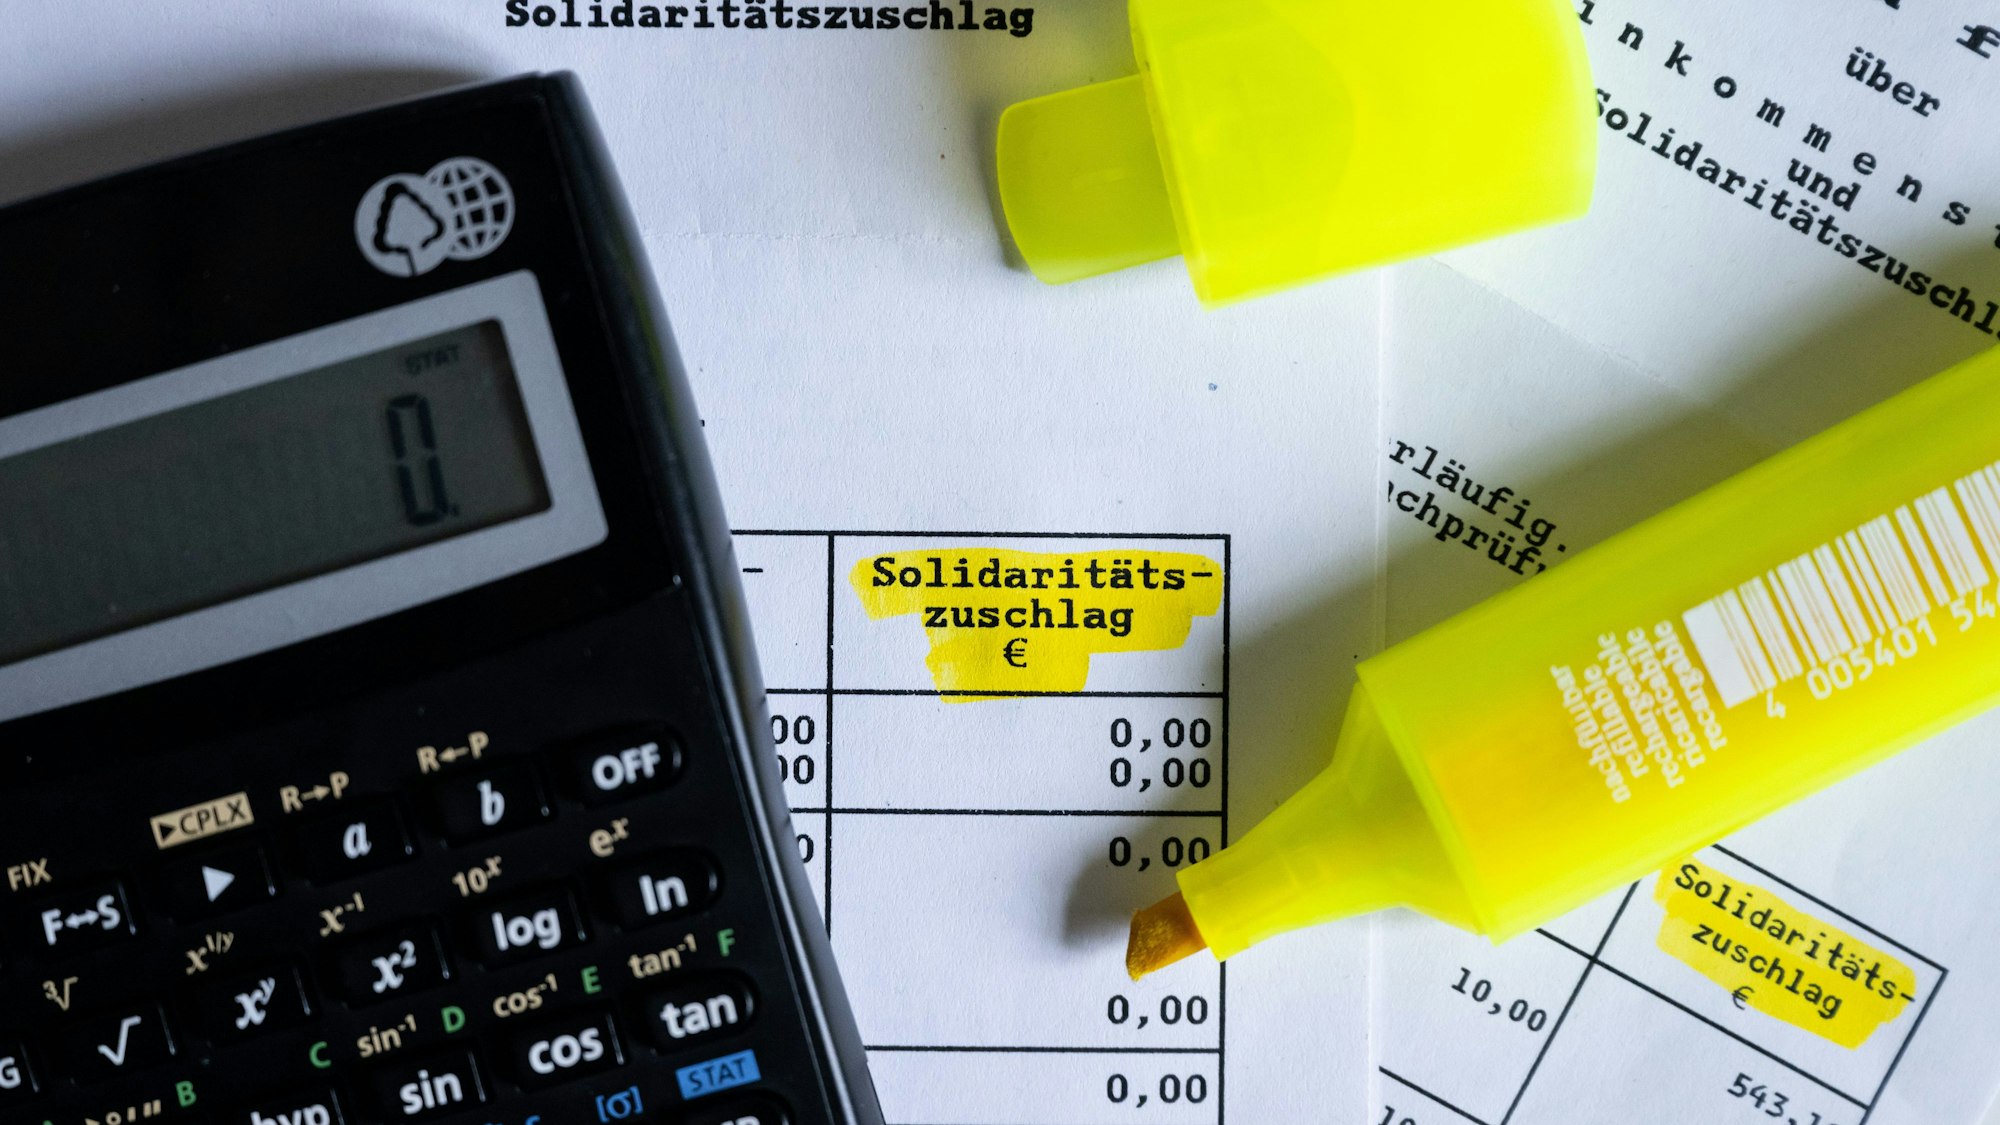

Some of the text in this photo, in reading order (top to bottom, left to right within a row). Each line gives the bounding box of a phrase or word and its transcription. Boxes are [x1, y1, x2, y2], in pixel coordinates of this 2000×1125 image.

[506, 0, 1035, 38] Solidaritätszuschlag
[1846, 46, 1940, 118] über
[1787, 158, 1861, 212] und
[1596, 88, 2000, 341] olidaritätszuschl
[405, 343, 460, 375] STAT
[1389, 438, 1566, 553] rläufig.
[1388, 481, 1546, 575] chprüf
[872, 556, 1213, 591] Solidaritäts-
[924, 598, 1134, 638] zuschlag
[1002, 638, 1028, 668] €
[1806, 614, 1937, 701] 005401
[1950, 587, 2000, 633] 54
[1109, 718, 1212, 752] 0,00
[1583, 663, 1649, 778] refillable
[592, 742, 661, 790] OFF
[1109, 757, 1211, 790] 0,00
[179, 799, 247, 837] CPLX
[477, 780, 505, 825] b
[343, 823, 372, 859] a
[1108, 836, 1210, 871] 0,00
[7, 857, 52, 891] FIX
[492, 908, 562, 951] log
[718, 928, 736, 957] F
[1674, 864, 1916, 1003] Solidaritäts-
[581, 966, 601, 994] E
[1691, 924, 1843, 1020] zuschlag
[660, 994, 738, 1039] tan
[1107, 994, 1208, 1030] 0,00
[1451, 967, 1548, 1034] 10,00
[1731, 985, 1755, 1011] €
[309, 1041, 332, 1069] C
[441, 1006, 466, 1033] D
[528, 1027, 604, 1074] cos
[175, 1080, 197, 1107] B
[400, 1069, 463, 1115] sin
[688, 1056, 747, 1093] STAT
[1106, 1073, 1207, 1108] 0,00
